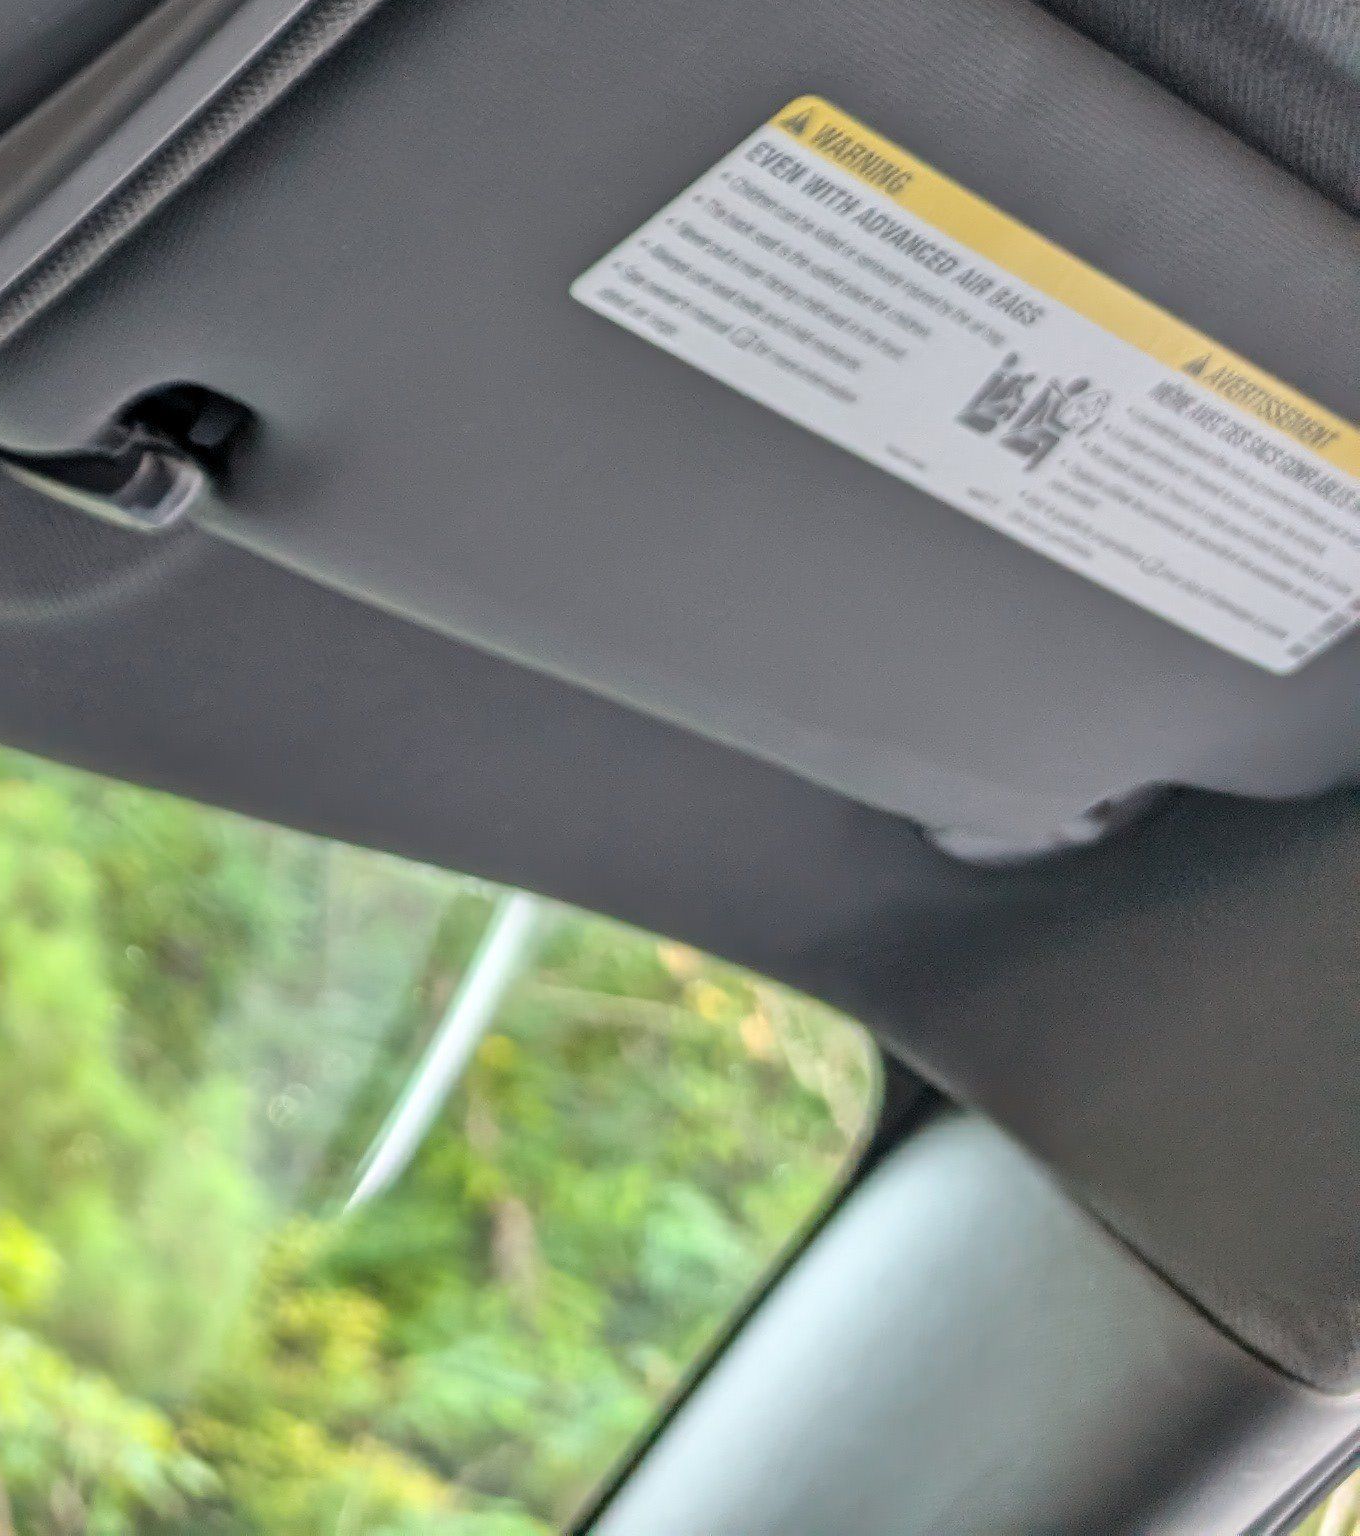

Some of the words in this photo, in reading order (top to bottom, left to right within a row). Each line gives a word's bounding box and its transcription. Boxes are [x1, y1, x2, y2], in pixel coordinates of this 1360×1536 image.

[811, 124, 915, 195] WARNING
[745, 140, 809, 186] EVEN
[801, 171, 861, 216] WITH
[853, 206, 960, 277] ADVANCED
[951, 267, 994, 297] AIR
[985, 285, 1046, 328] BAGS
